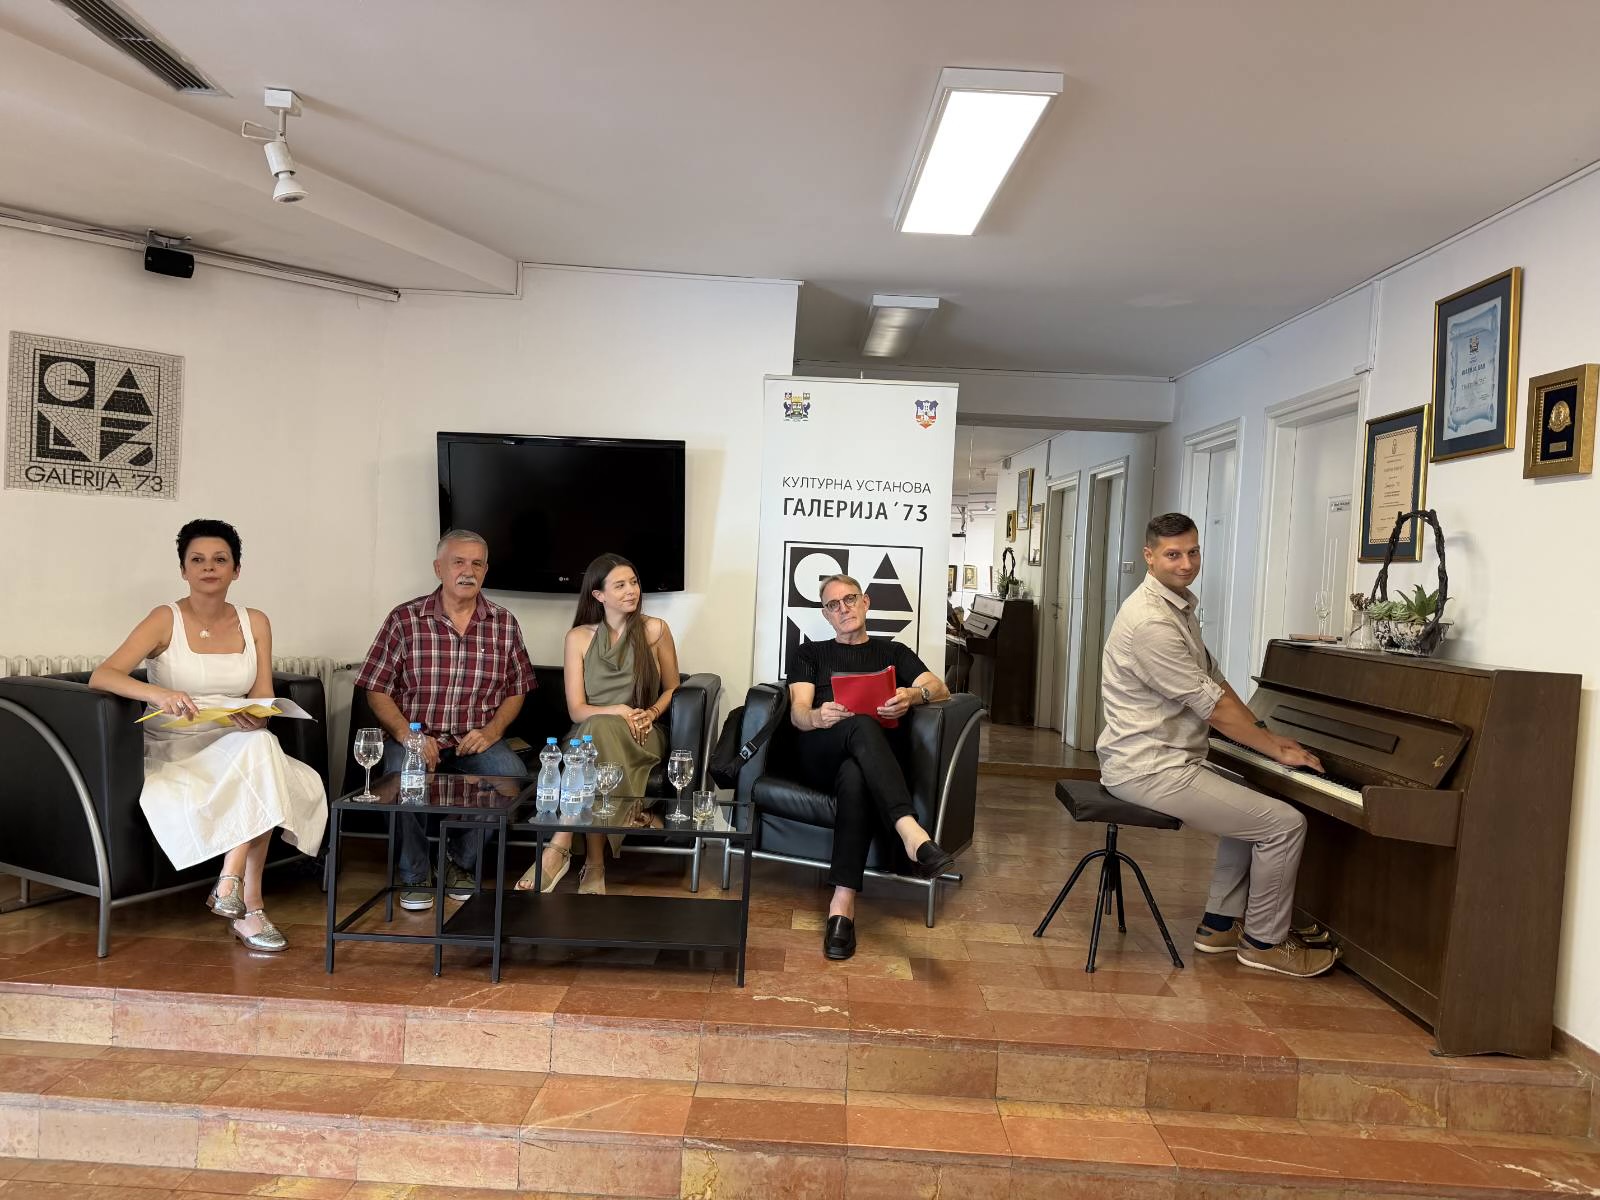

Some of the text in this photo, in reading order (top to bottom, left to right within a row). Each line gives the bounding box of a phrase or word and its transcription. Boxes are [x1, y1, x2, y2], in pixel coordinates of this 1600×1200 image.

[24, 465, 163, 492] GALERIJA '73
[782, 476, 931, 494] КУЛТУРНА УСТАНОВА
[783, 497, 888, 520] ГАЛЕРИЈА
